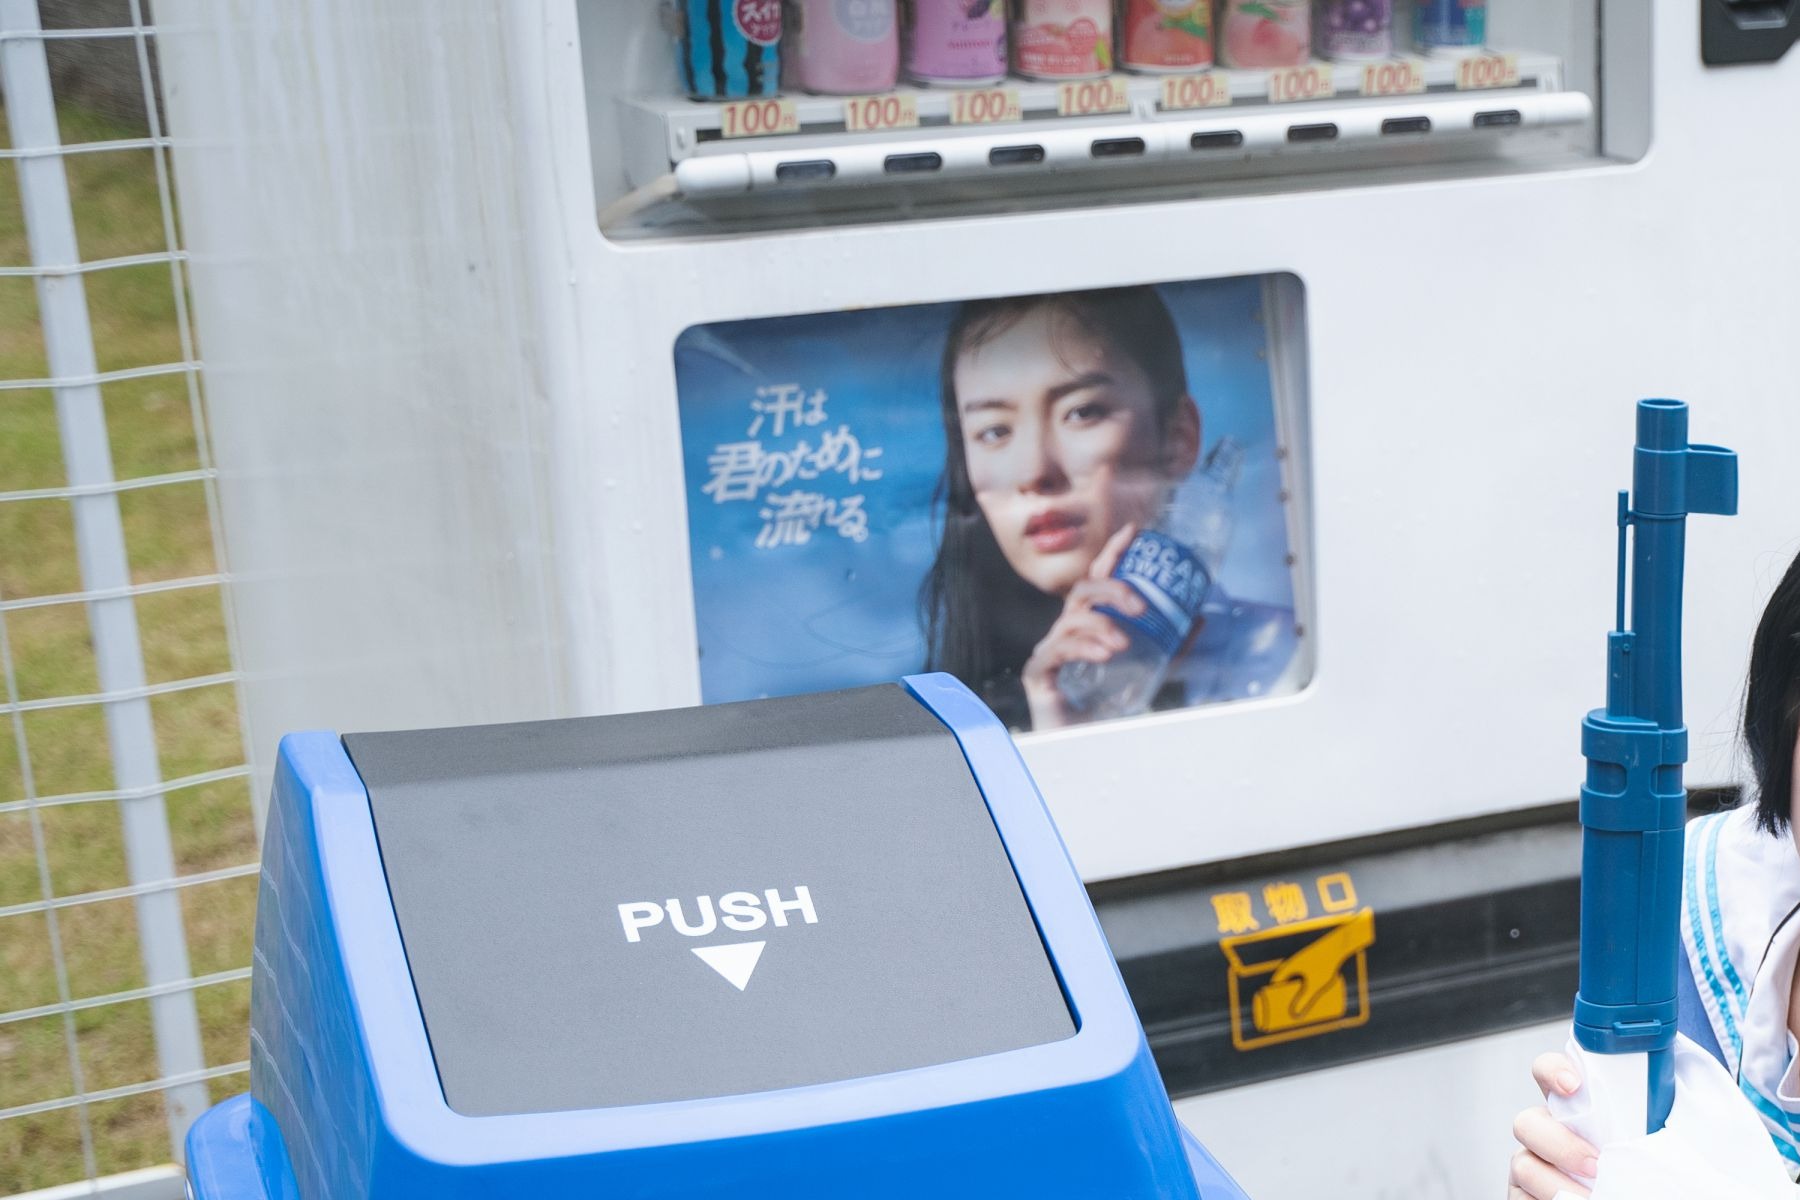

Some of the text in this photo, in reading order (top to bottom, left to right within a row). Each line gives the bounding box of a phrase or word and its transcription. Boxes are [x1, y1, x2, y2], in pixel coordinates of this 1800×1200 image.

[747, 383, 829, 438] 汗は
[701, 424, 884, 504] 君のために
[617, 885, 819, 943] PUSH
